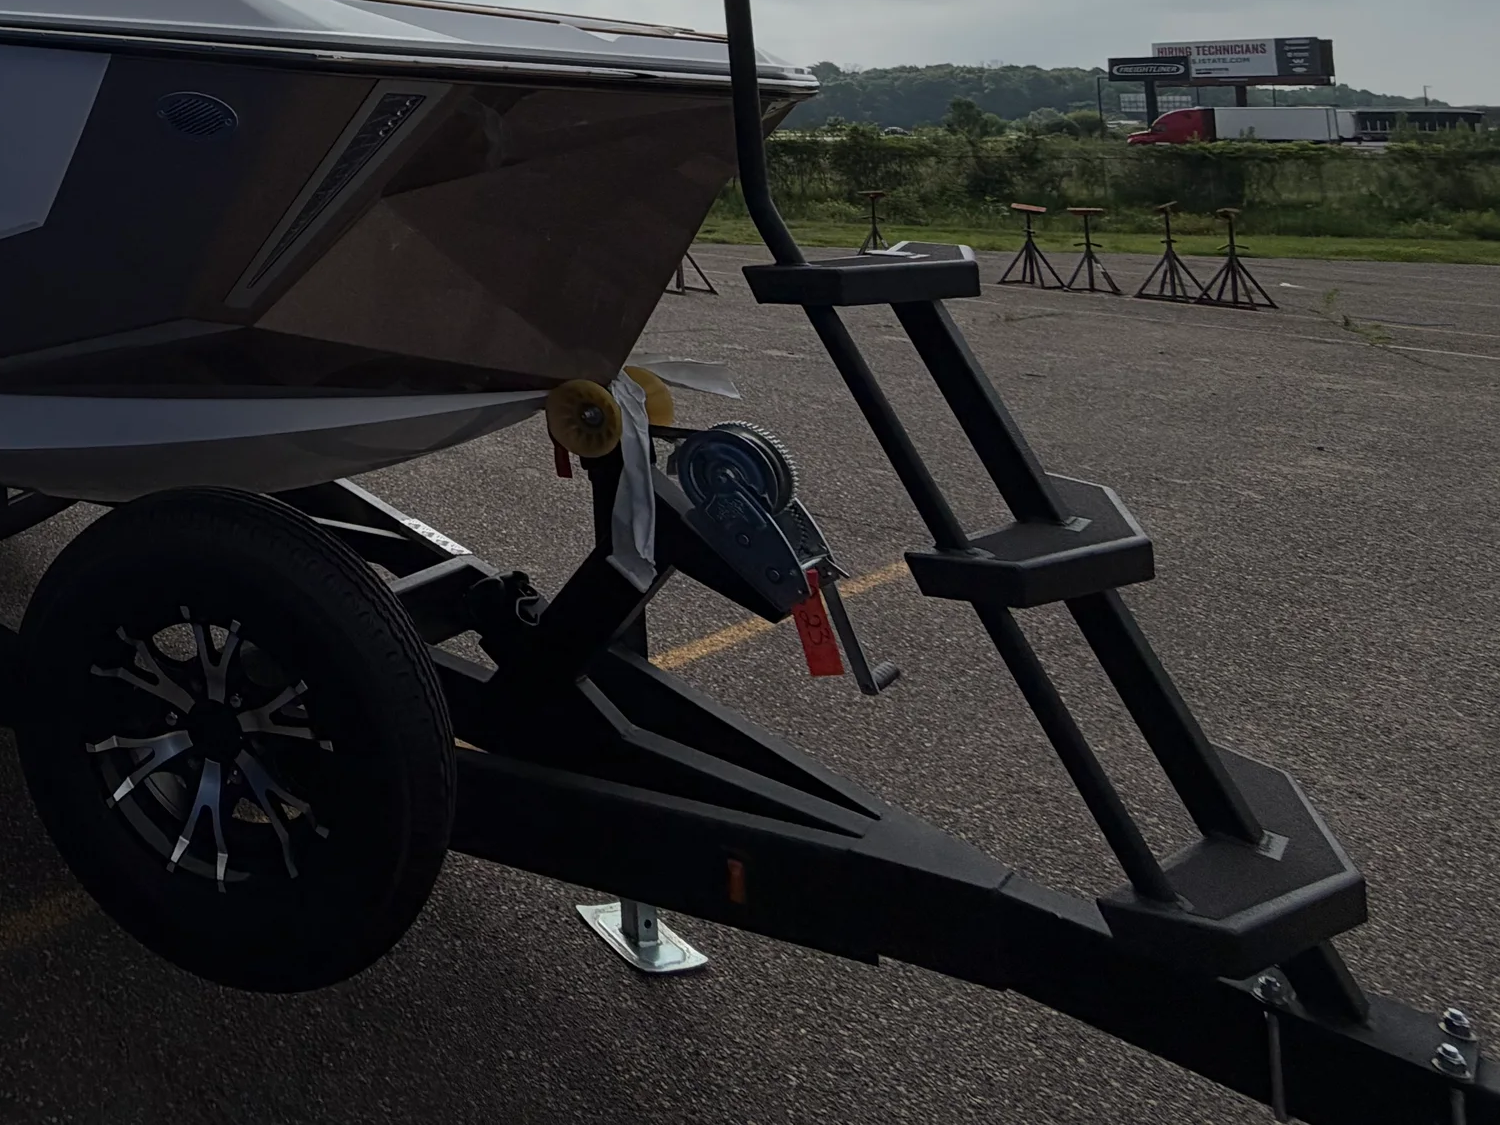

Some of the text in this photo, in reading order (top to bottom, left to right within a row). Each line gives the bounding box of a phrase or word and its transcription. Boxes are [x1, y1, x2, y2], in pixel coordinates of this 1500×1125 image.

[1157, 43, 1267, 58] HIRING TECHNICIANS
[1119, 65, 1179, 73] FREIGHTLINER
